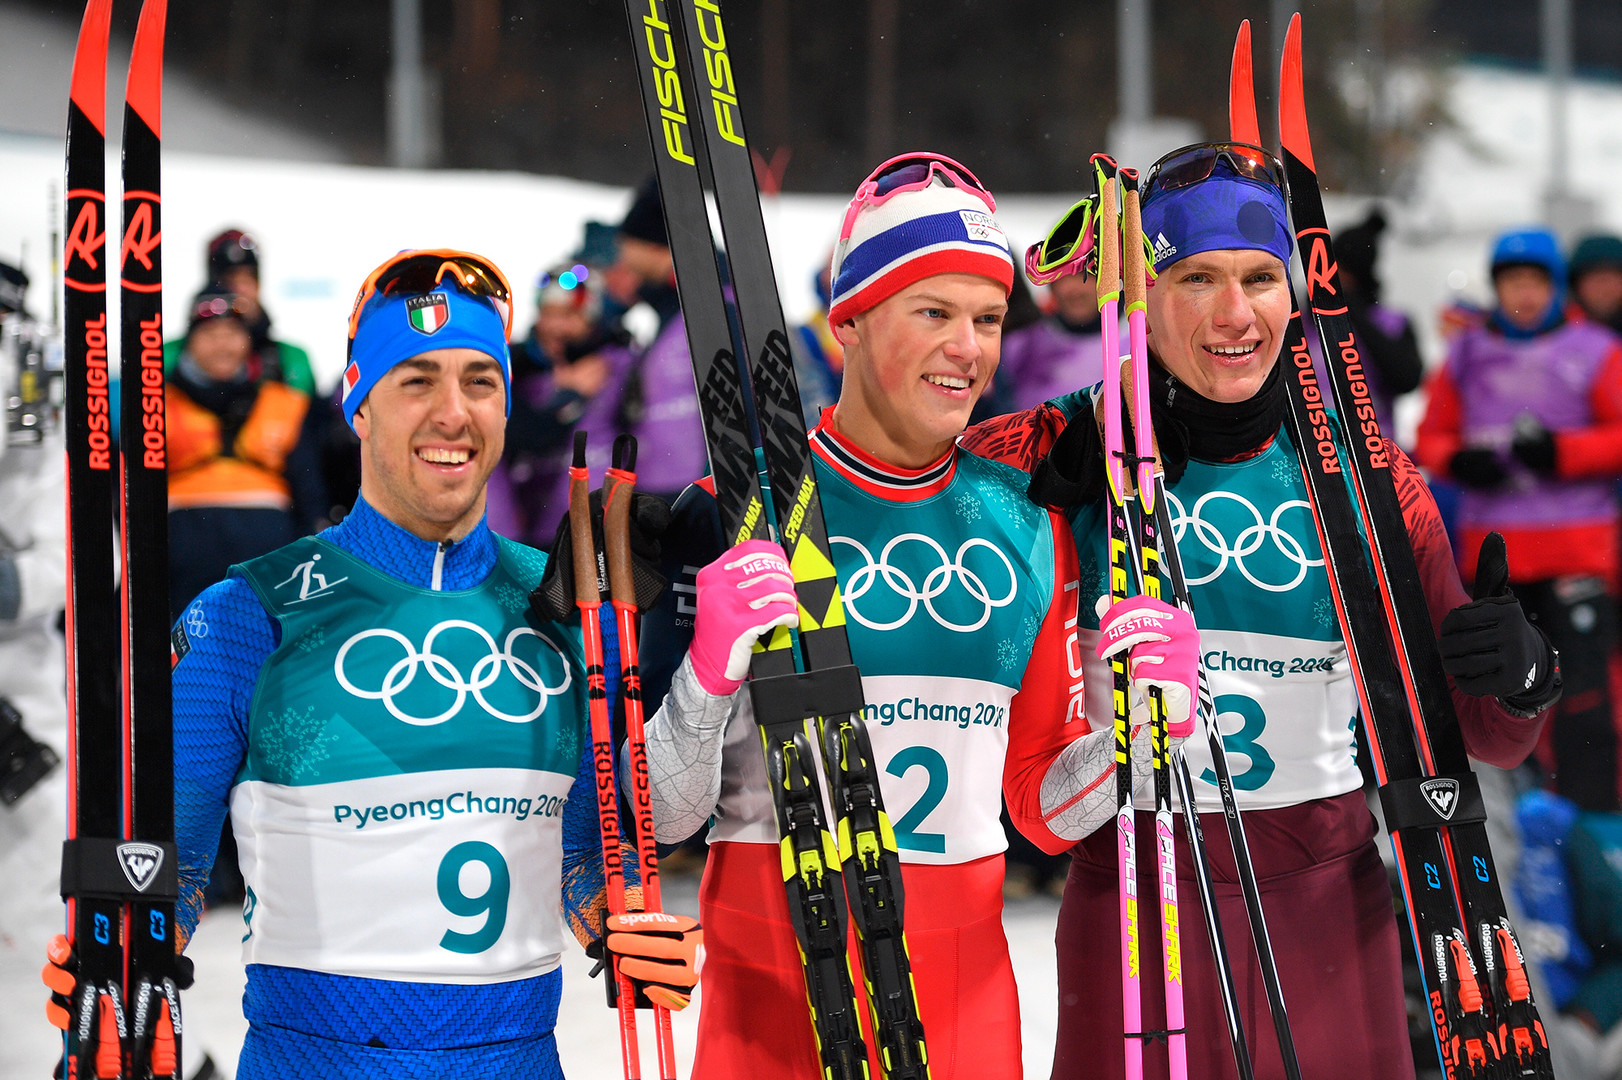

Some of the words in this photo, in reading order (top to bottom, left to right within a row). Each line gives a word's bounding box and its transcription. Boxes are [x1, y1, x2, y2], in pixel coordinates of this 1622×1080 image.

[643, 0, 695, 166] FISCH
[408, 294, 443, 306] ITALIA
[85, 312, 111, 470] ROSSIGNOL
[140, 312, 166, 469] ROSSIGNOL
[1291, 335, 1342, 474] ROSSIGNOL
[1338, 332, 1389, 470] ROSSIGNOL
[744, 496, 762, 531] MAX
[785, 503, 804, 544] SPEED
[797, 474, 815, 509] MAX
[742, 559, 793, 576] HESTRA
[1142, 546, 1161, 600] LE
[1108, 617, 1163, 641] HESTRA
[863, 698, 971, 729] ngChang
[1197, 694, 1276, 791] 3
[333, 791, 532, 829] PyeongChang
[593, 742, 624, 885] ROSSIGNOL
[885, 746, 949, 854] 2
[1425, 782, 1455, 791] ROSSIGNOL
[1424, 862, 1441, 889] C2
[1472, 855, 1490, 883] C2
[149, 909, 165, 941] C3
[437, 841, 510, 954] 9
[94, 911, 110, 945] C3
[1126, 898, 1140, 980] SHARK
[1164, 902, 1181, 986] SHARK
[1481, 923, 1495, 973] ROSSIGNOL
[1434, 934, 1448, 984] ROSSIGNOL
[79, 985, 96, 1041] ROSSIGNOL
[134, 982, 151, 1038] ROSSIGNOL
